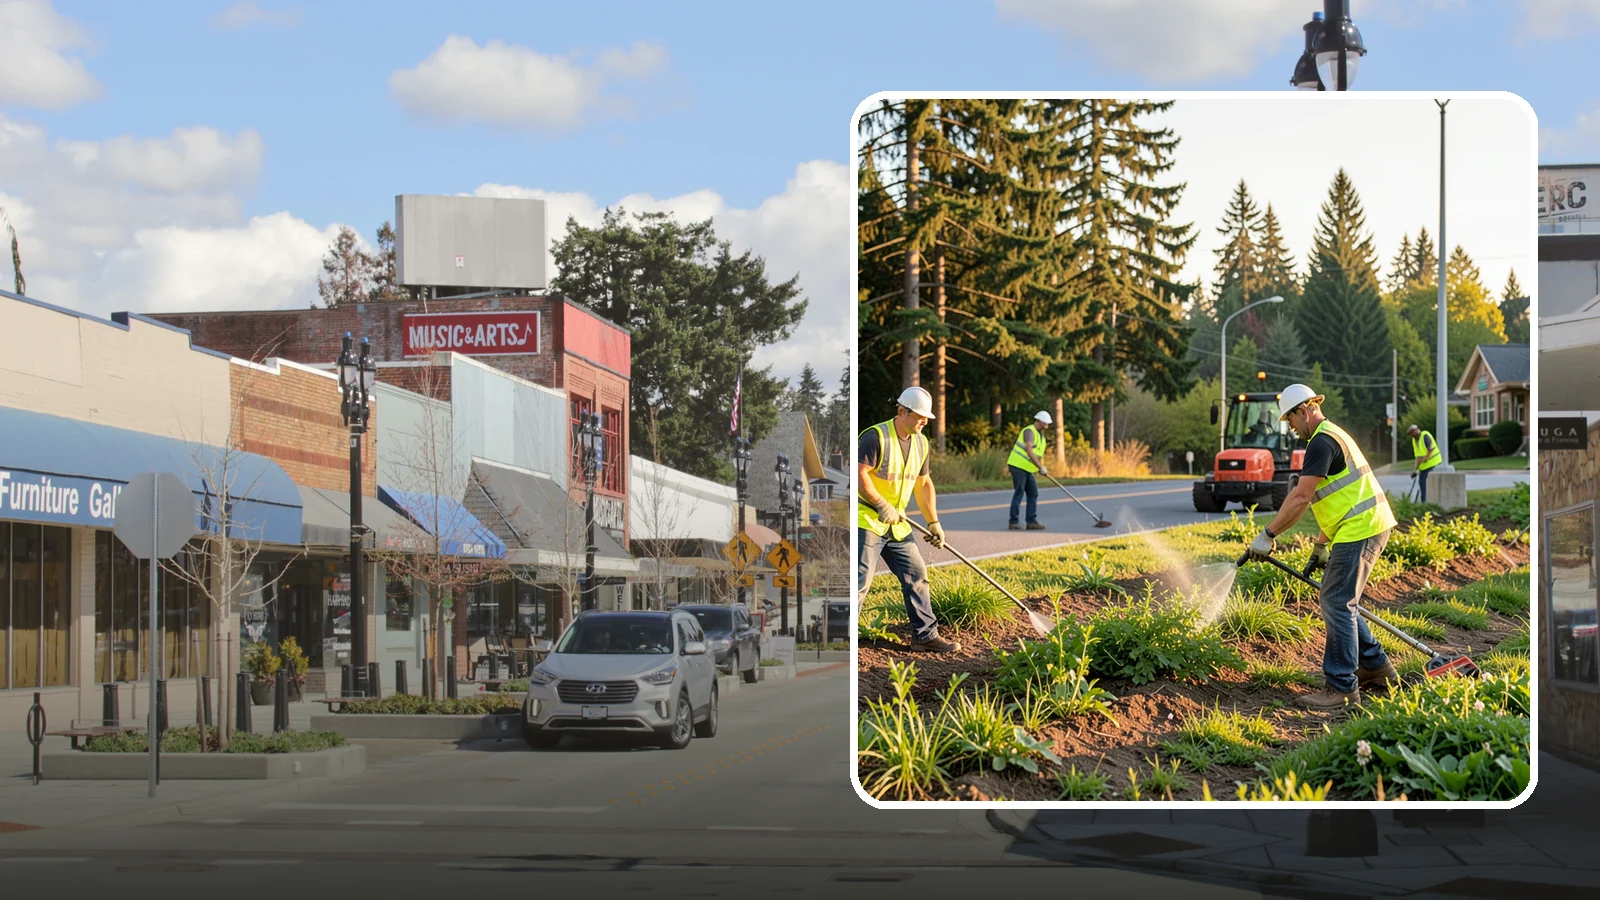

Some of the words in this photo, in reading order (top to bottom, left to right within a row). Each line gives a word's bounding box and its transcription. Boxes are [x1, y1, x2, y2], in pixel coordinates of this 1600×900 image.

[0, 471, 79, 515] Furniture
[89, 482, 122, 519] Gal
[453, 563, 479, 574] SUSHI
